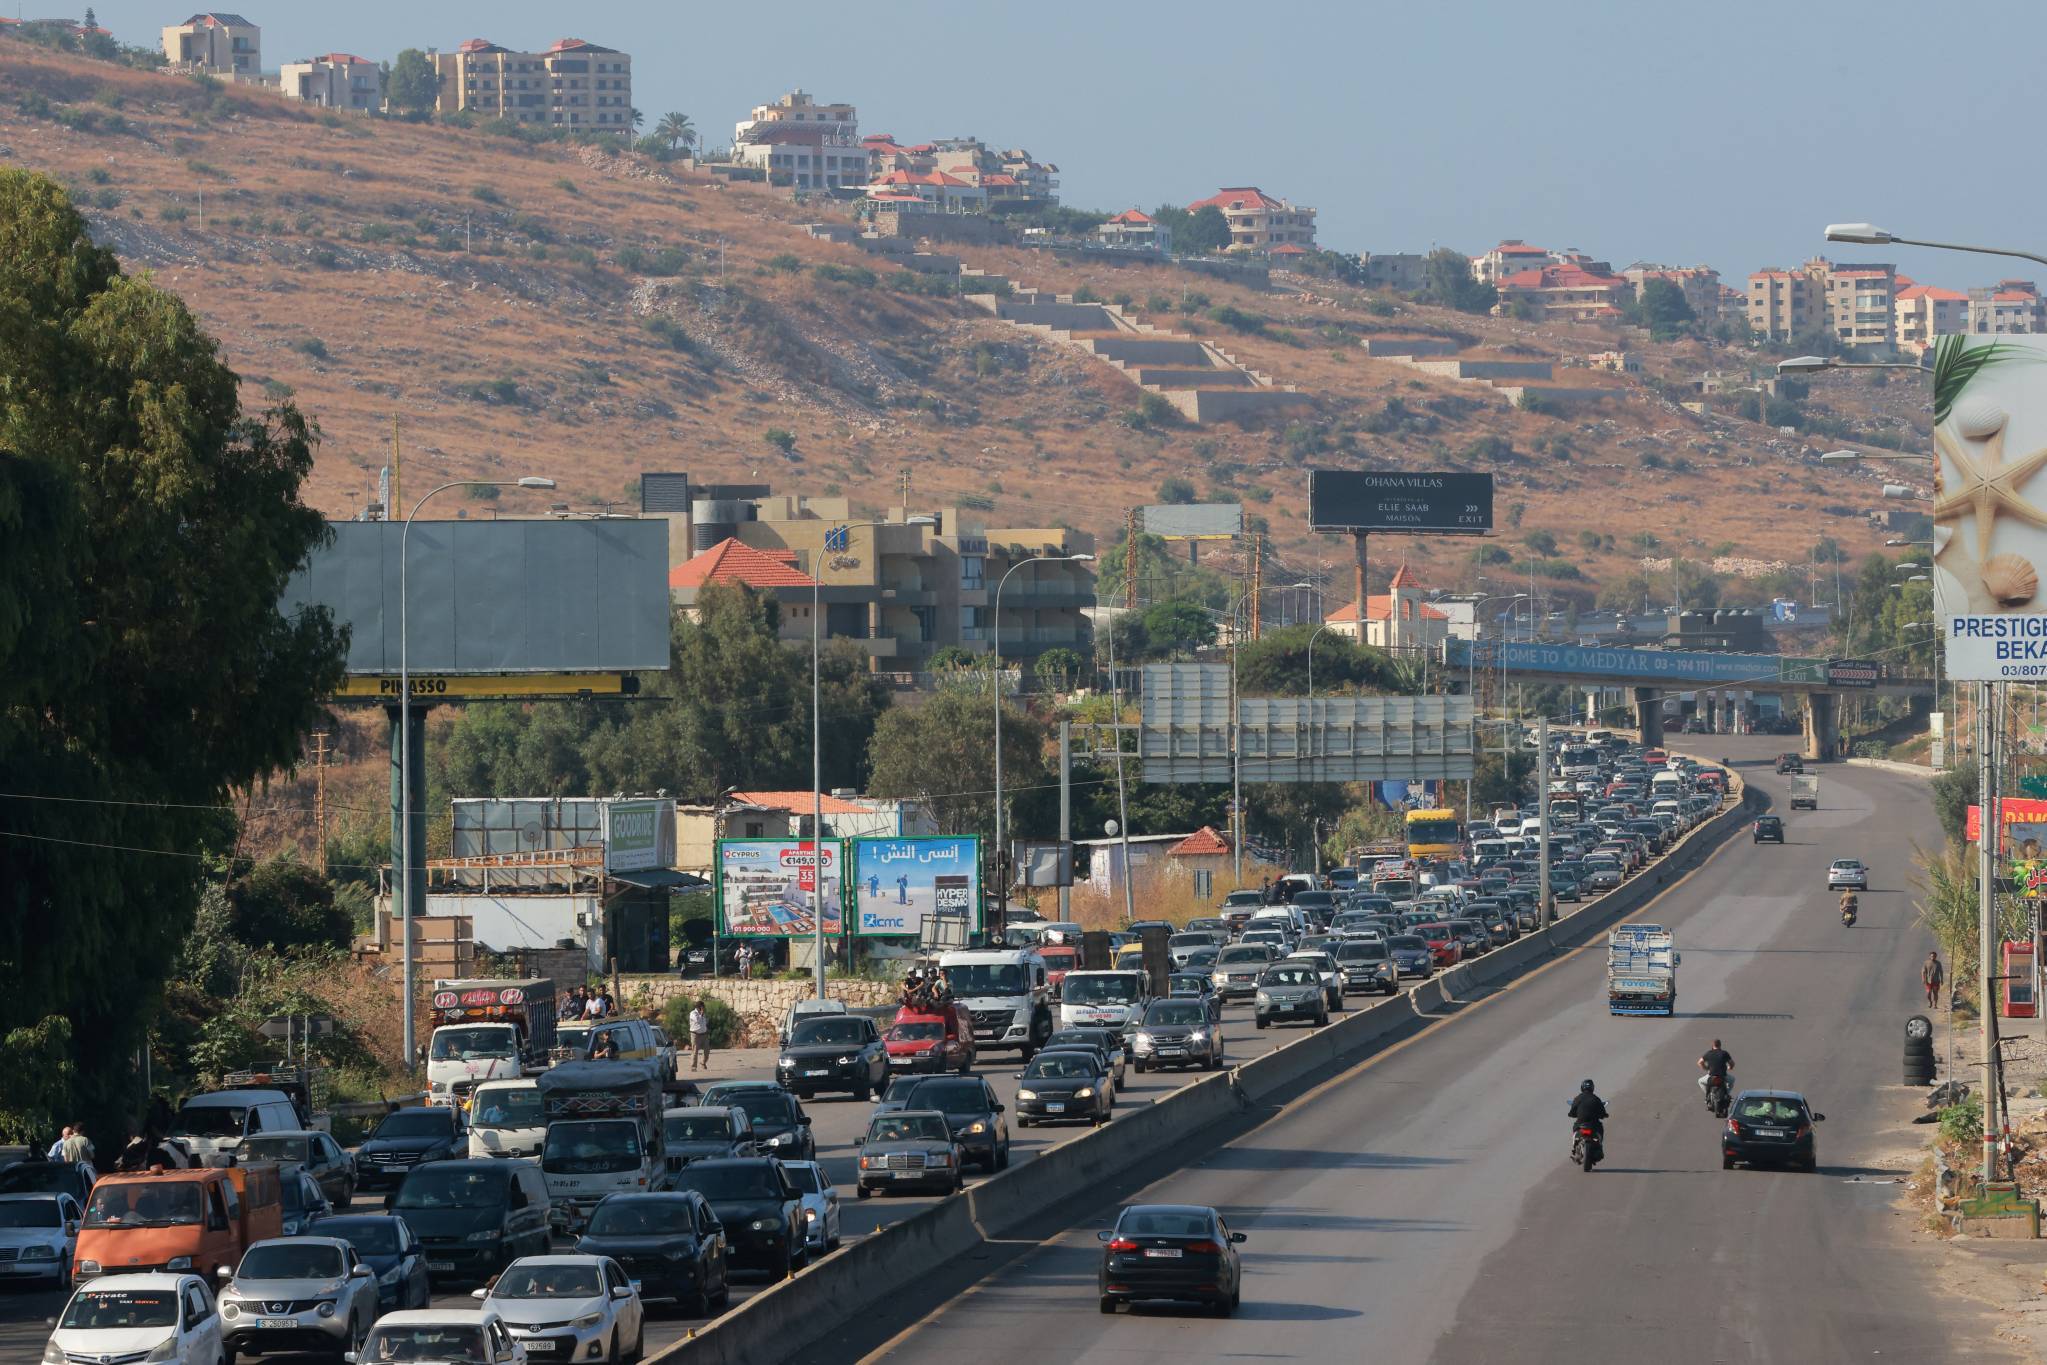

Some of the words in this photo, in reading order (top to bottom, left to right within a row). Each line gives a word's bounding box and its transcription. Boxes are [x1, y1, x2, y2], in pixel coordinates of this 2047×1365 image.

[1365, 477, 1405, 488] OHANA
[1407, 478, 1443, 488] VILLAS
[1378, 503, 1400, 512] ELIE
[1405, 504, 1429, 512] SAAB
[1386, 514, 1421, 523] MAISON
[1458, 516, 1483, 524] EXIT
[1542, 650, 1559, 664] TO
[1581, 652, 1648, 671] MEDYAR
[1655, 658, 1668, 669] 03
[1788, 672, 1808, 681] EXIT
[614, 813, 653, 838] GOODRIDE
[786, 857, 828, 865] €149,00
[801, 871, 814, 880] 35
[936, 888, 968, 898] HYPER
[937, 898, 968, 908] DESMO
